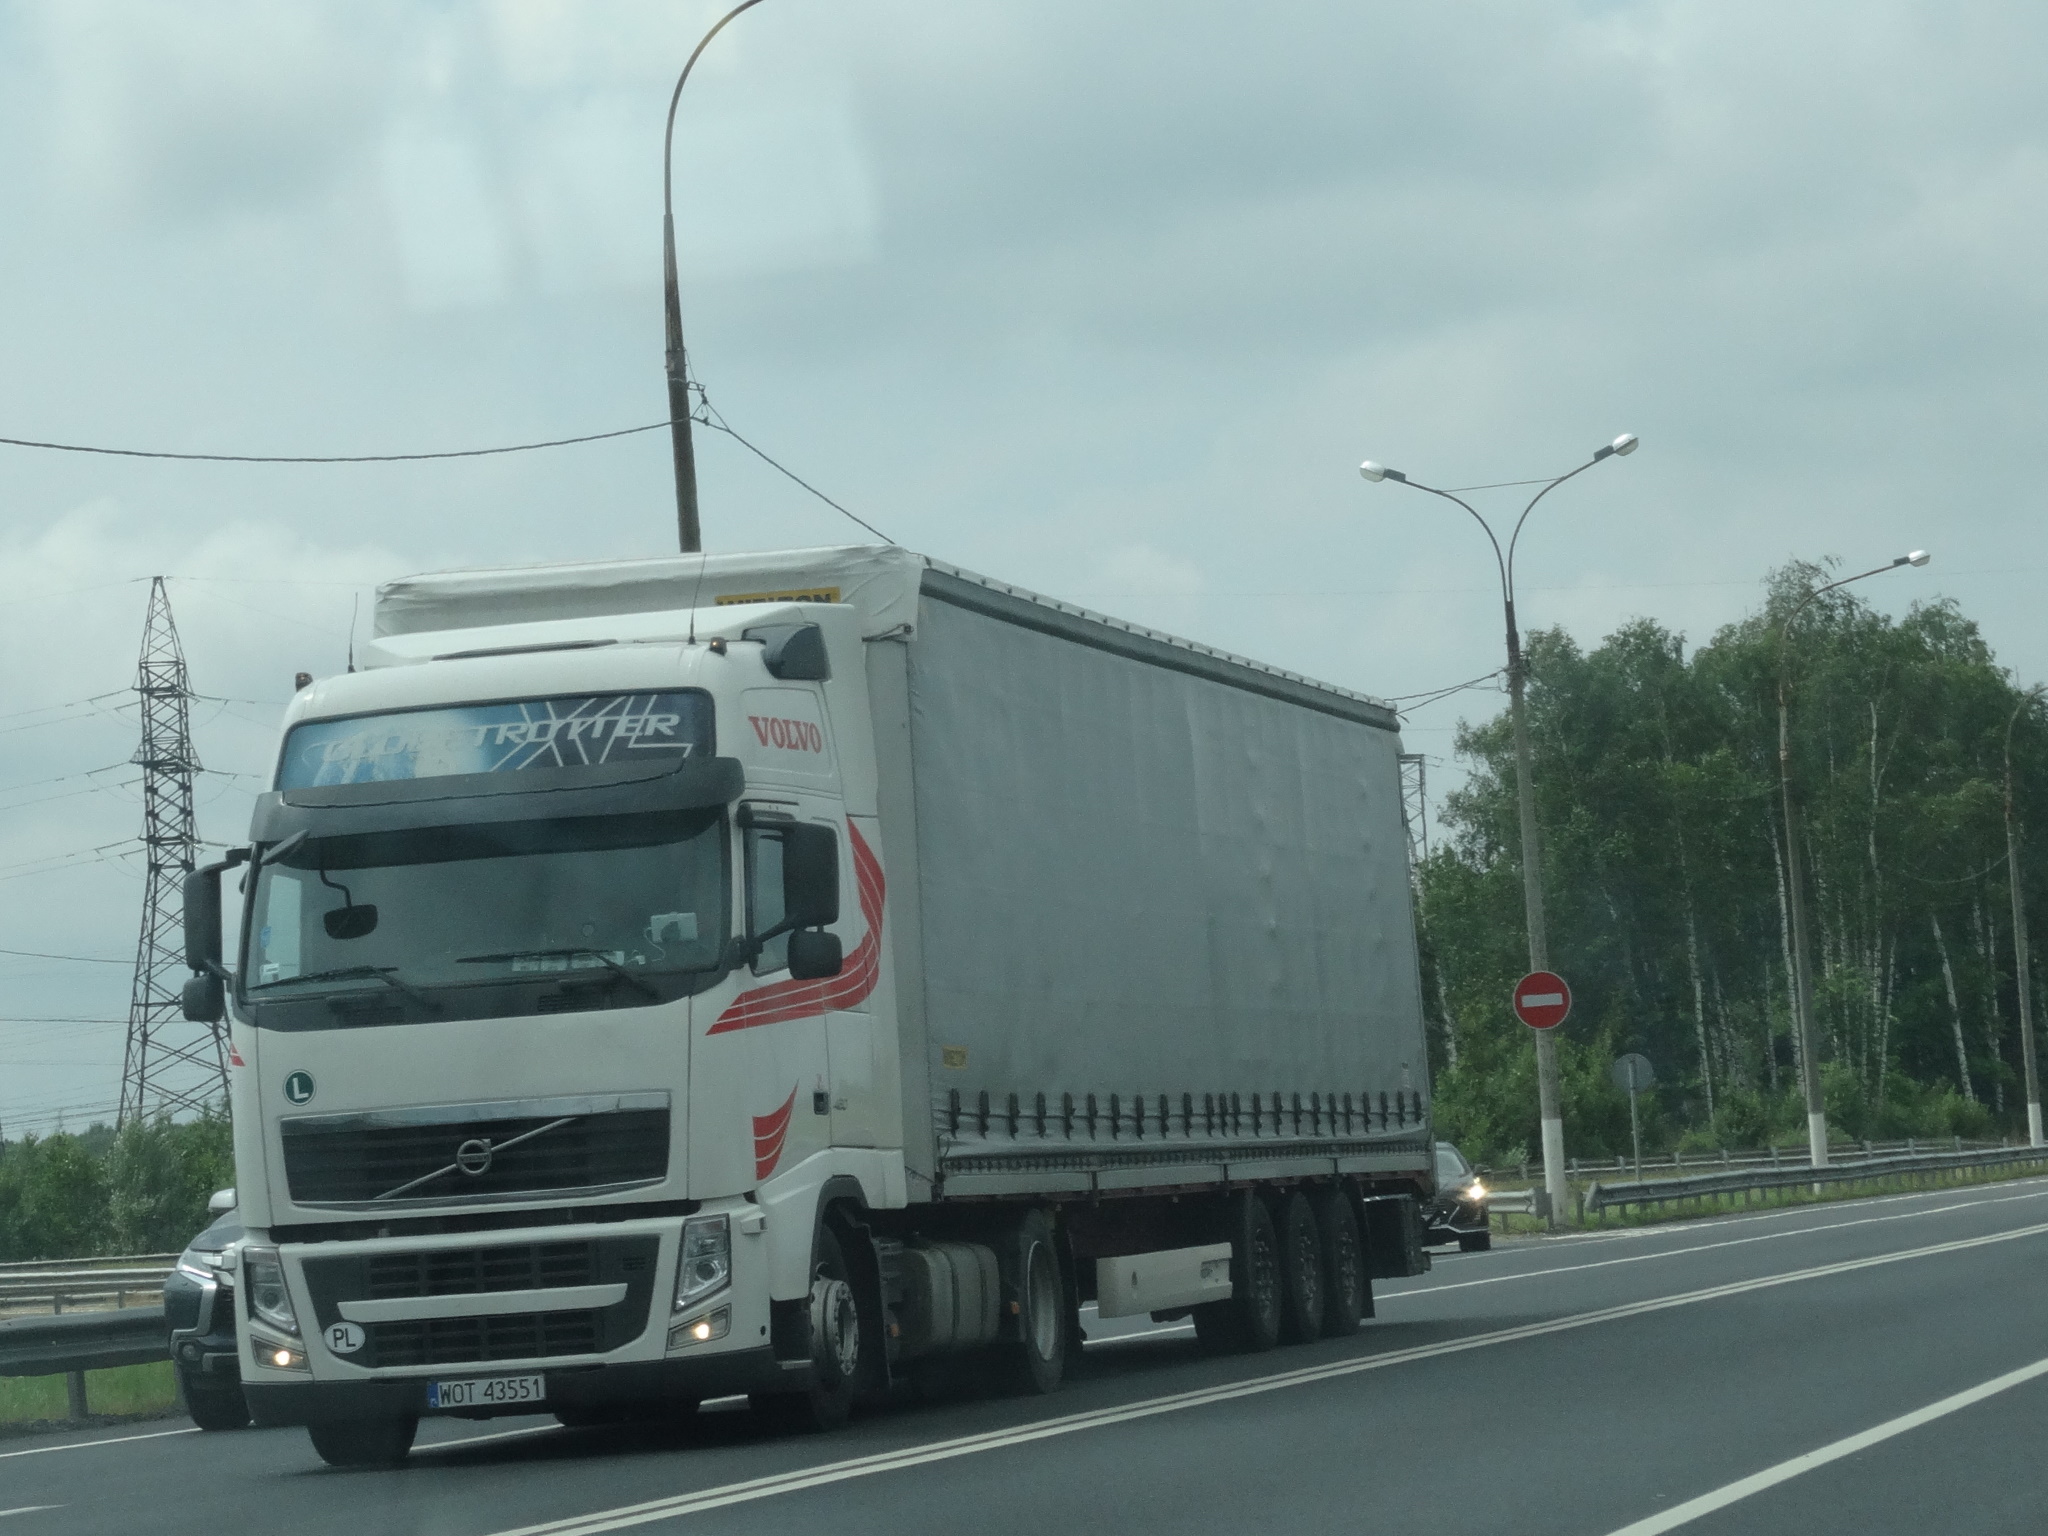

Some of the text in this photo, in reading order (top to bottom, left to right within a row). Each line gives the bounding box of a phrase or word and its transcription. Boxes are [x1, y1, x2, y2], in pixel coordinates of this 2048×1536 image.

[322, 714, 682, 763] GLOTROTTER
[747, 715, 822, 754] VOLVO
[293, 1077, 309, 1099] L
[333, 1328, 356, 1348] PL
[440, 1378, 540, 1405] WOT 43551
